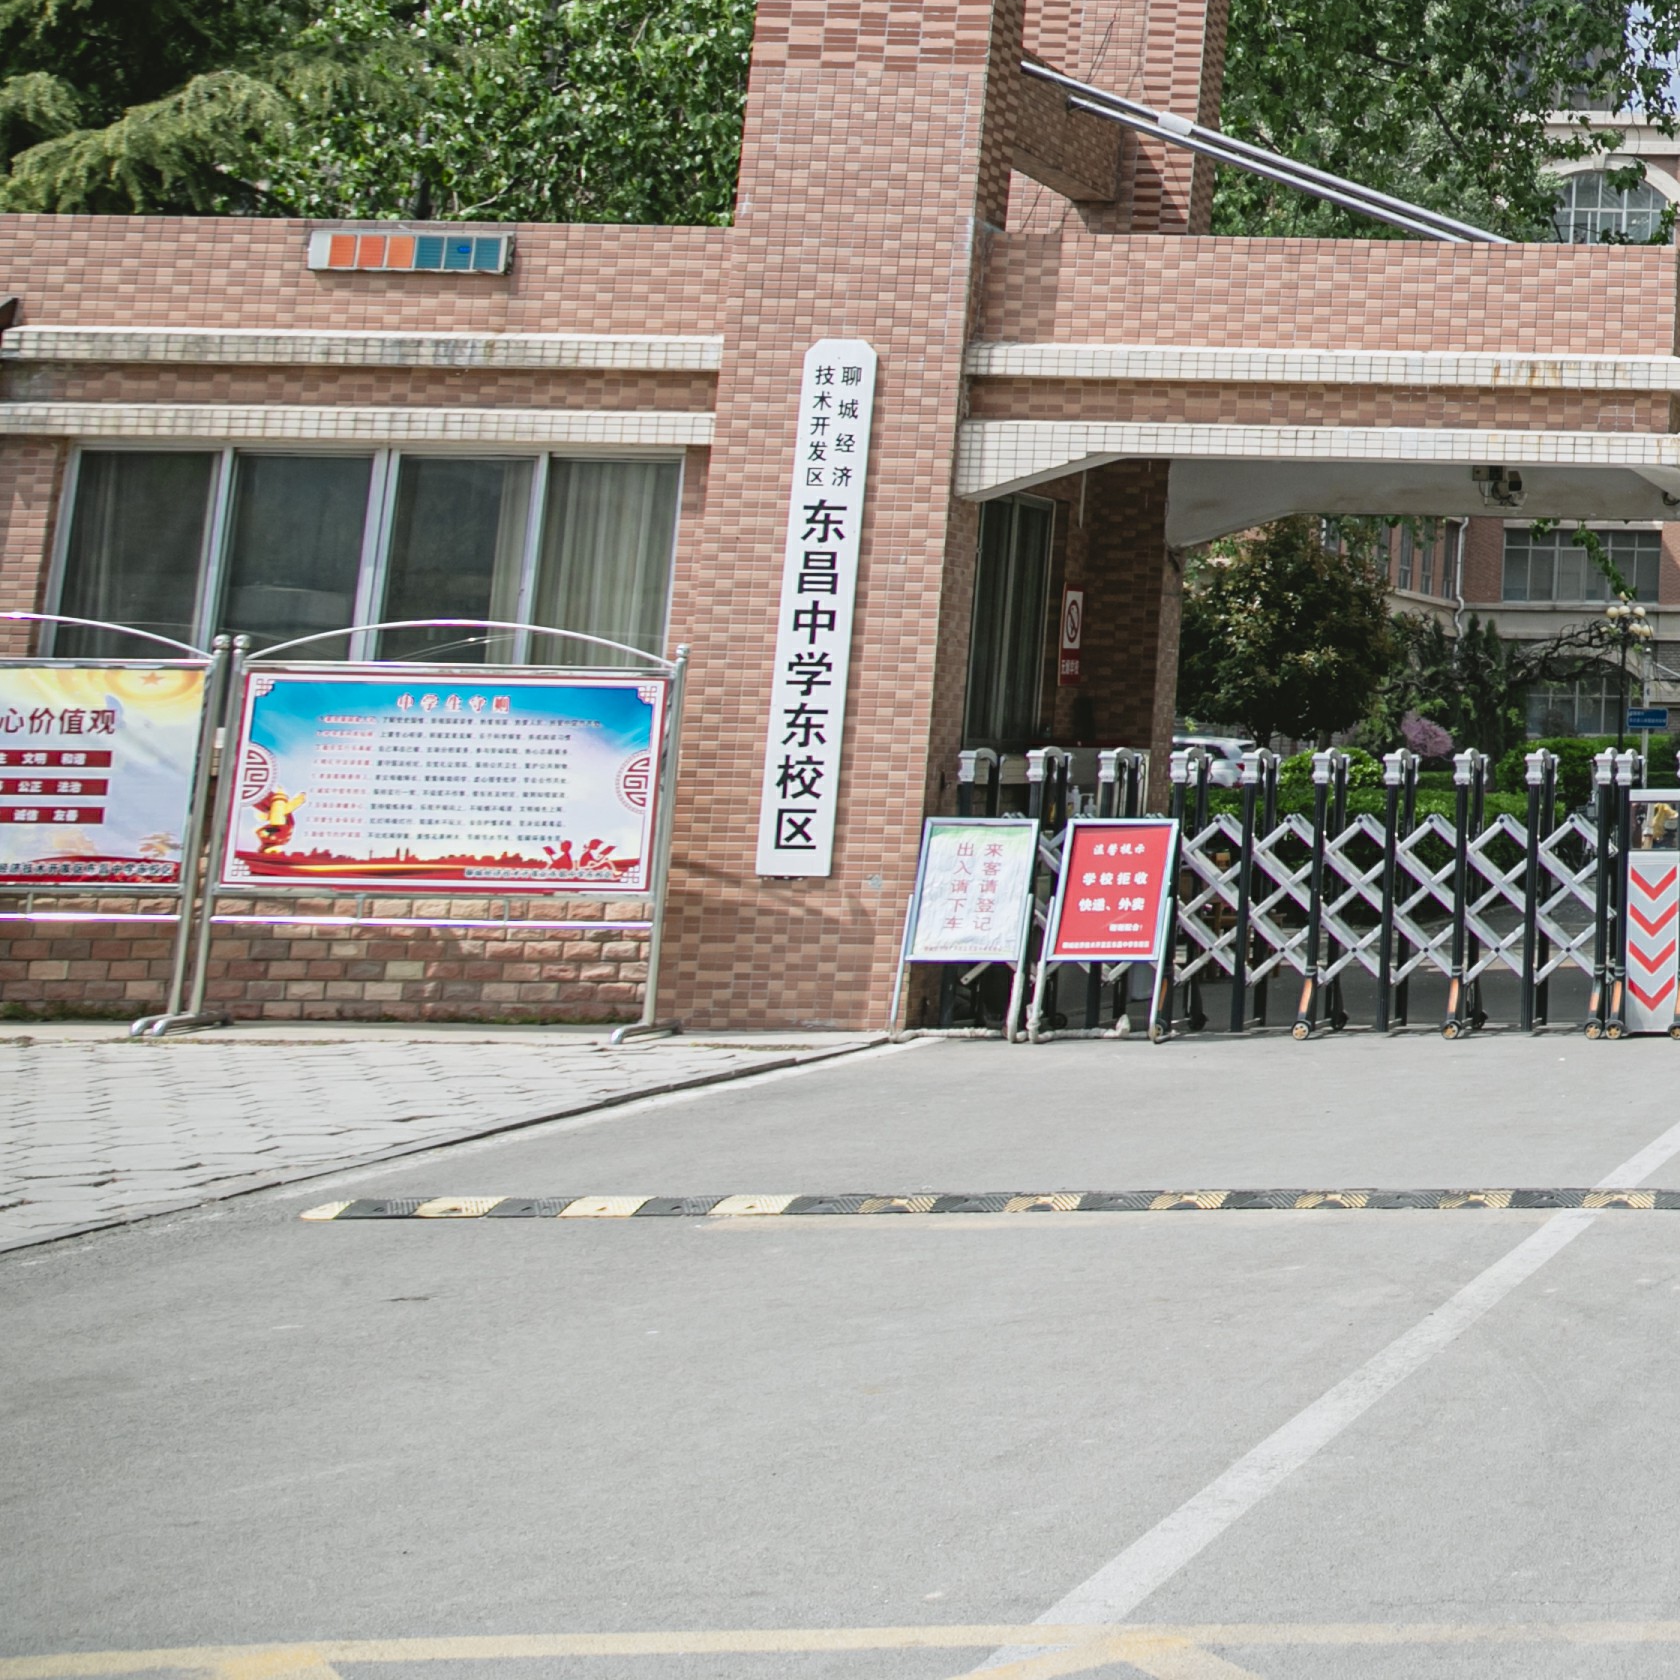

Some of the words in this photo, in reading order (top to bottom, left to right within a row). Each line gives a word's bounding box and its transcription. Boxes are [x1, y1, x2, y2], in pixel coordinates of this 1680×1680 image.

[806, 365, 836, 487] 技术开发区
[831, 366, 862, 487] 聊城经济
[397, 693, 511, 713] 中学生守则
[774, 499, 848, 850] 东昌中学东校区
[0, 707, 116, 735] 心价值观
[943, 842, 975, 931] 出入请下车
[973, 842, 1004, 932] 来客请登记
[1082, 871, 1149, 886] 学校拒收
